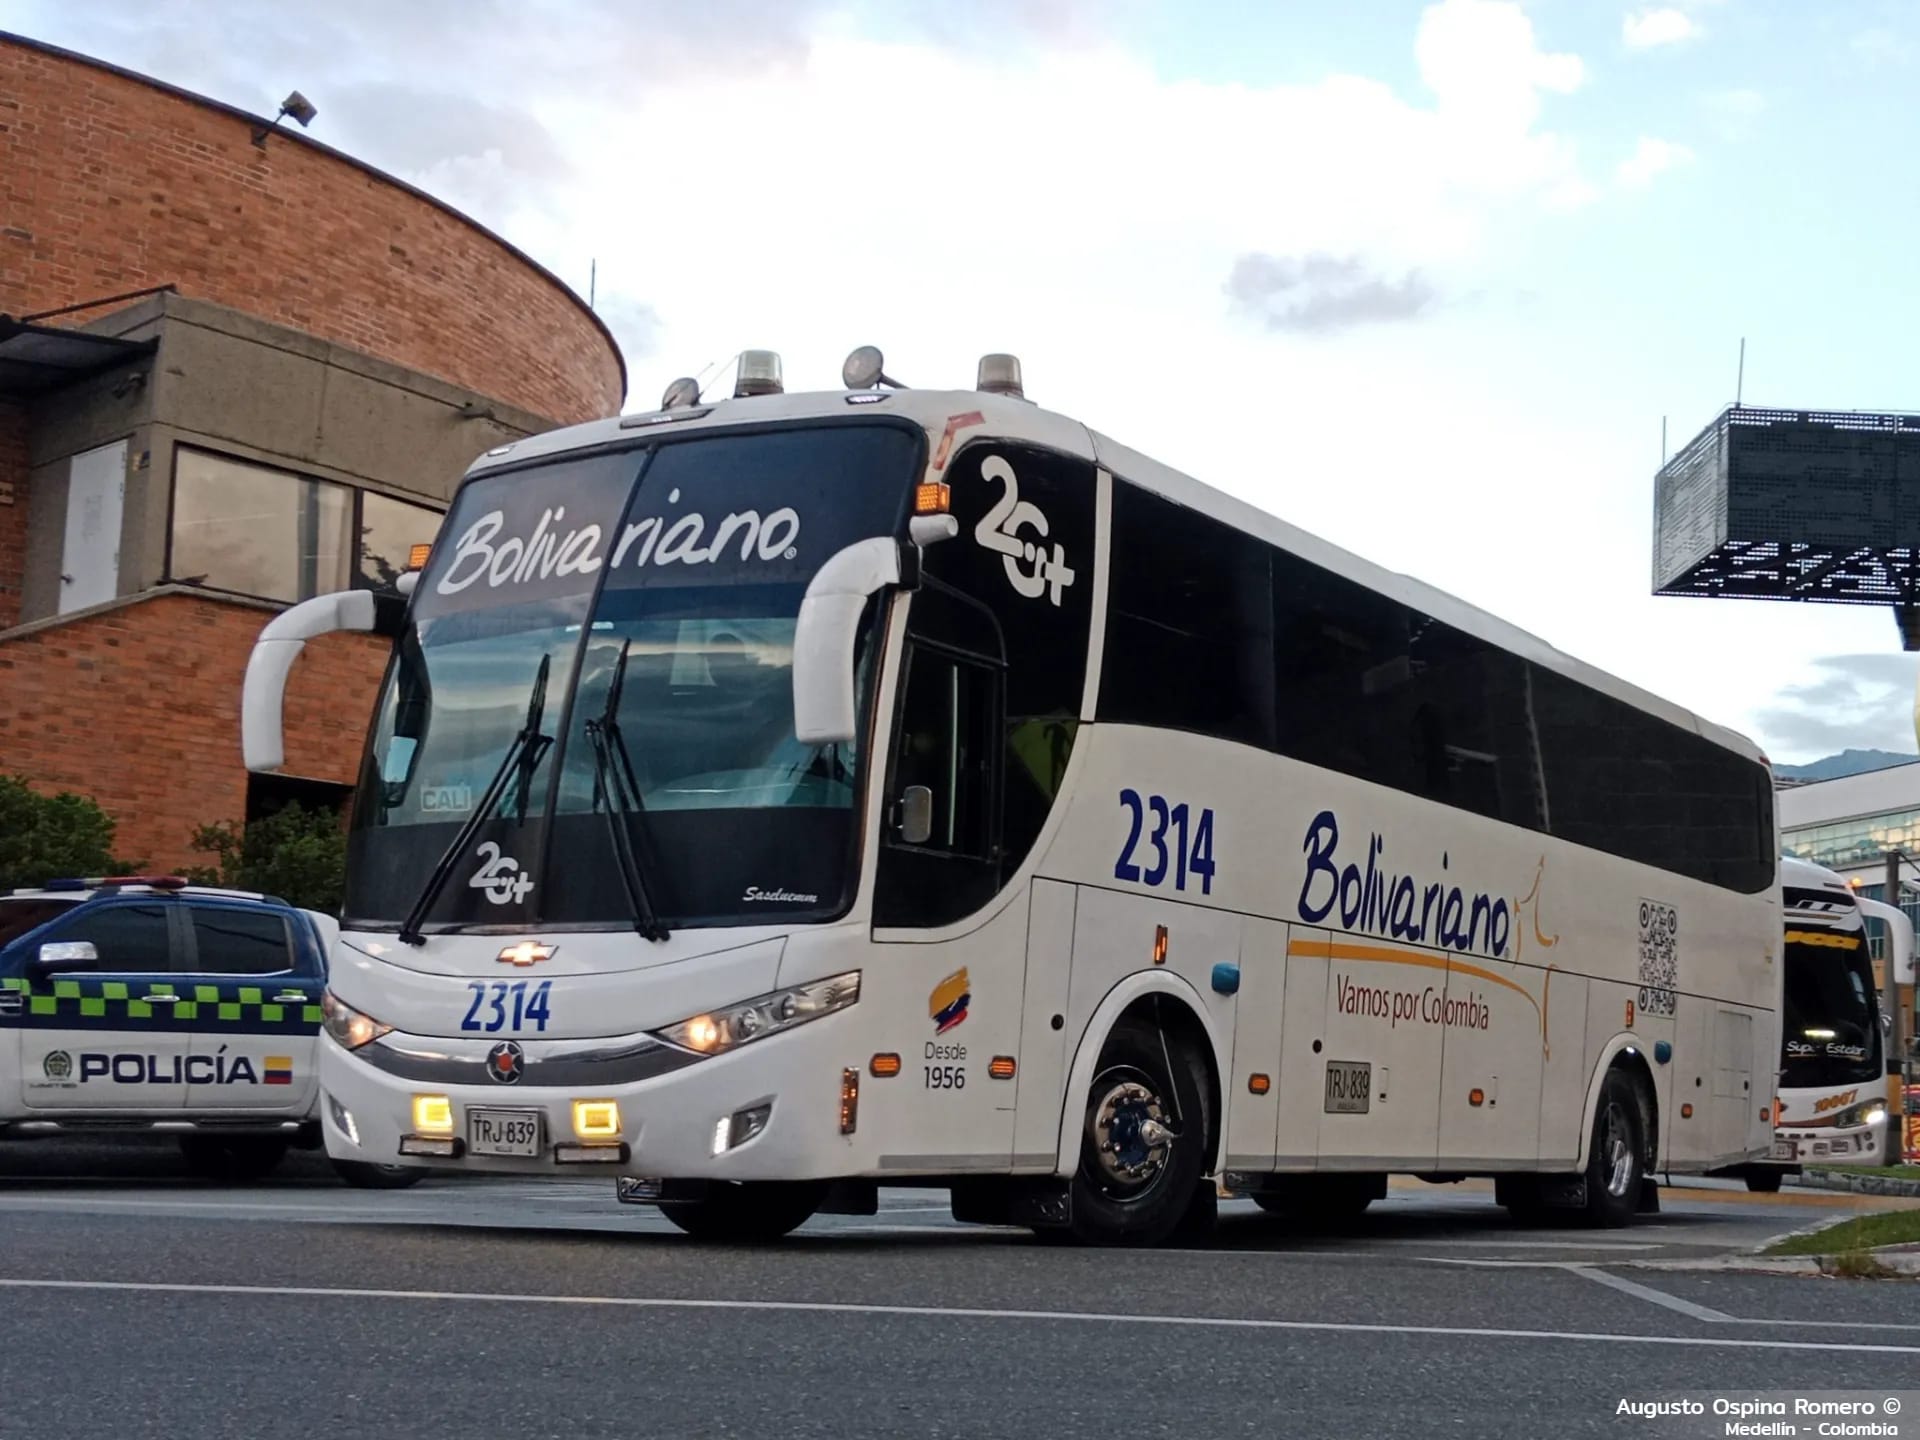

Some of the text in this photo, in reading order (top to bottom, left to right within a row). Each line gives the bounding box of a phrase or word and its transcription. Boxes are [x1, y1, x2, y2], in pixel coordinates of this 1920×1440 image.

[423, 790, 469, 810] CALI
[1114, 789, 1216, 895] 2314
[1298, 810, 1509, 957] Bolivariano
[461, 981, 550, 1031] 2314
[1337, 974, 1489, 1030] Vamos por Colombia
[80, 1044, 257, 1084] POLICÍA
[925, 1042, 966, 1060] Desde
[924, 1066, 965, 1089] 1956
